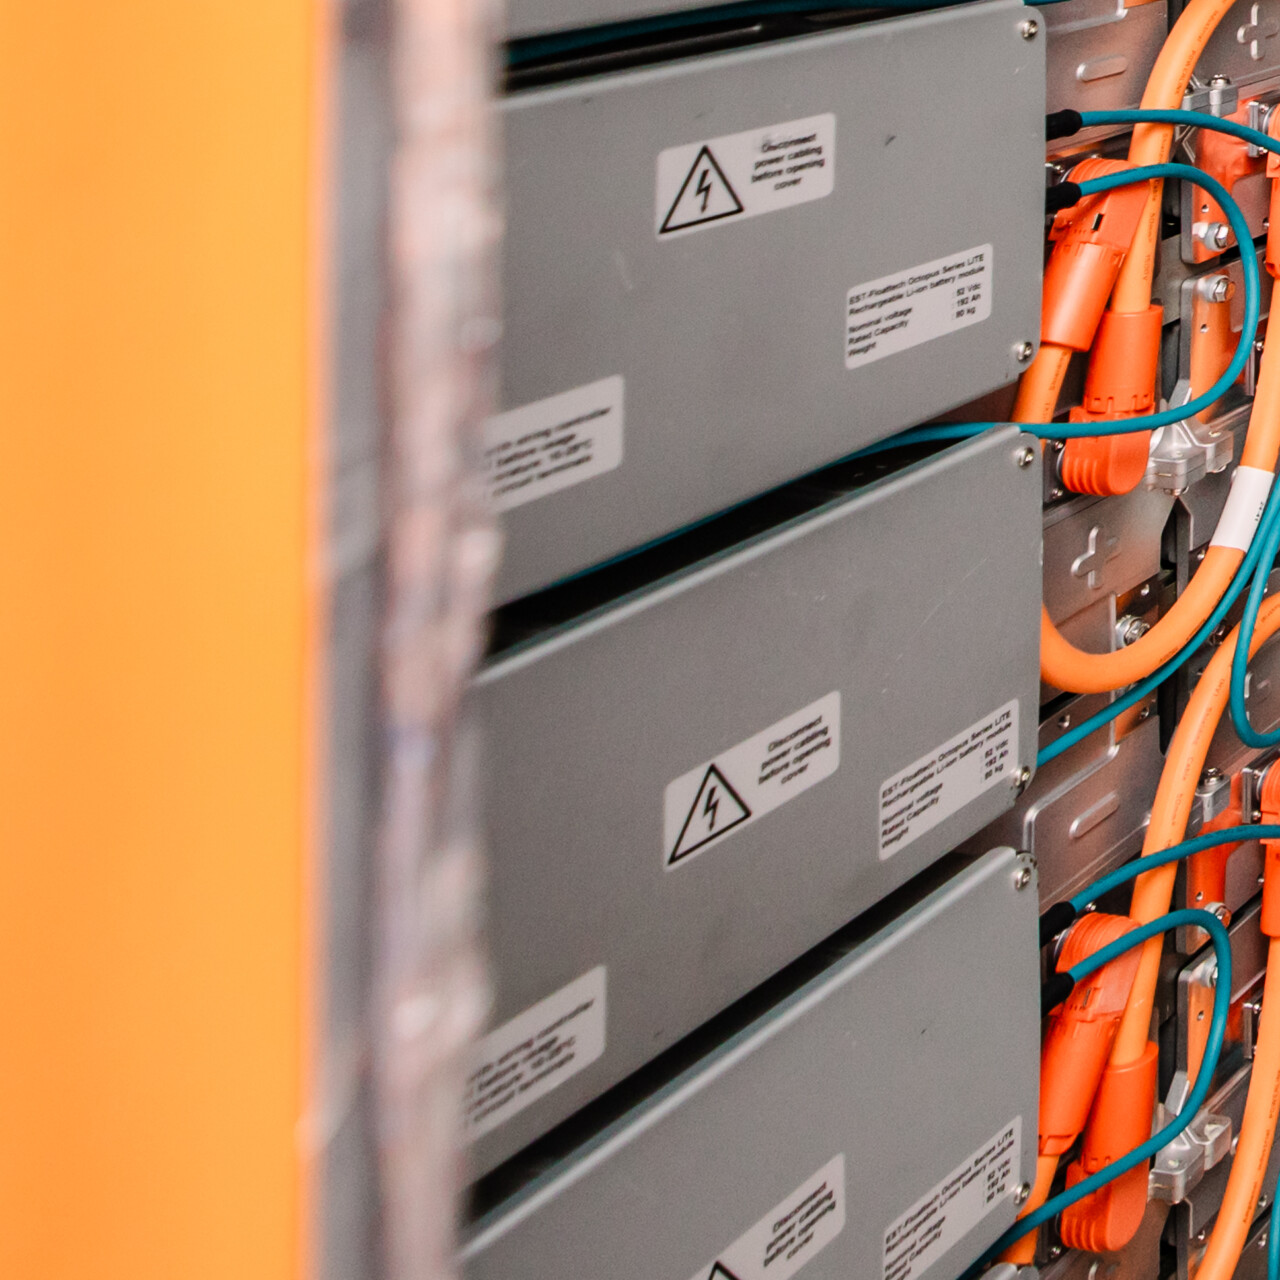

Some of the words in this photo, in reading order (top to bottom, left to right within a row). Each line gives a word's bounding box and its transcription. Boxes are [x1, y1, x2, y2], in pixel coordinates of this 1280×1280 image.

[930, 274, 956, 291] battery
[958, 264, 985, 280] module
[942, 259, 965, 274] Series
[884, 305, 913, 324] voltage
[767, 714, 822, 754] Disconnect
[959, 738, 984, 762] battery
[986, 720, 1012, 743] module
[971, 721, 993, 742] Series
[761, 746, 790, 772] power
[793, 724, 828, 754] cabling
[758, 760, 789, 786] before
[792, 737, 830, 768] opening
[781, 762, 808, 785] cover
[916, 781, 943, 807] voltage
